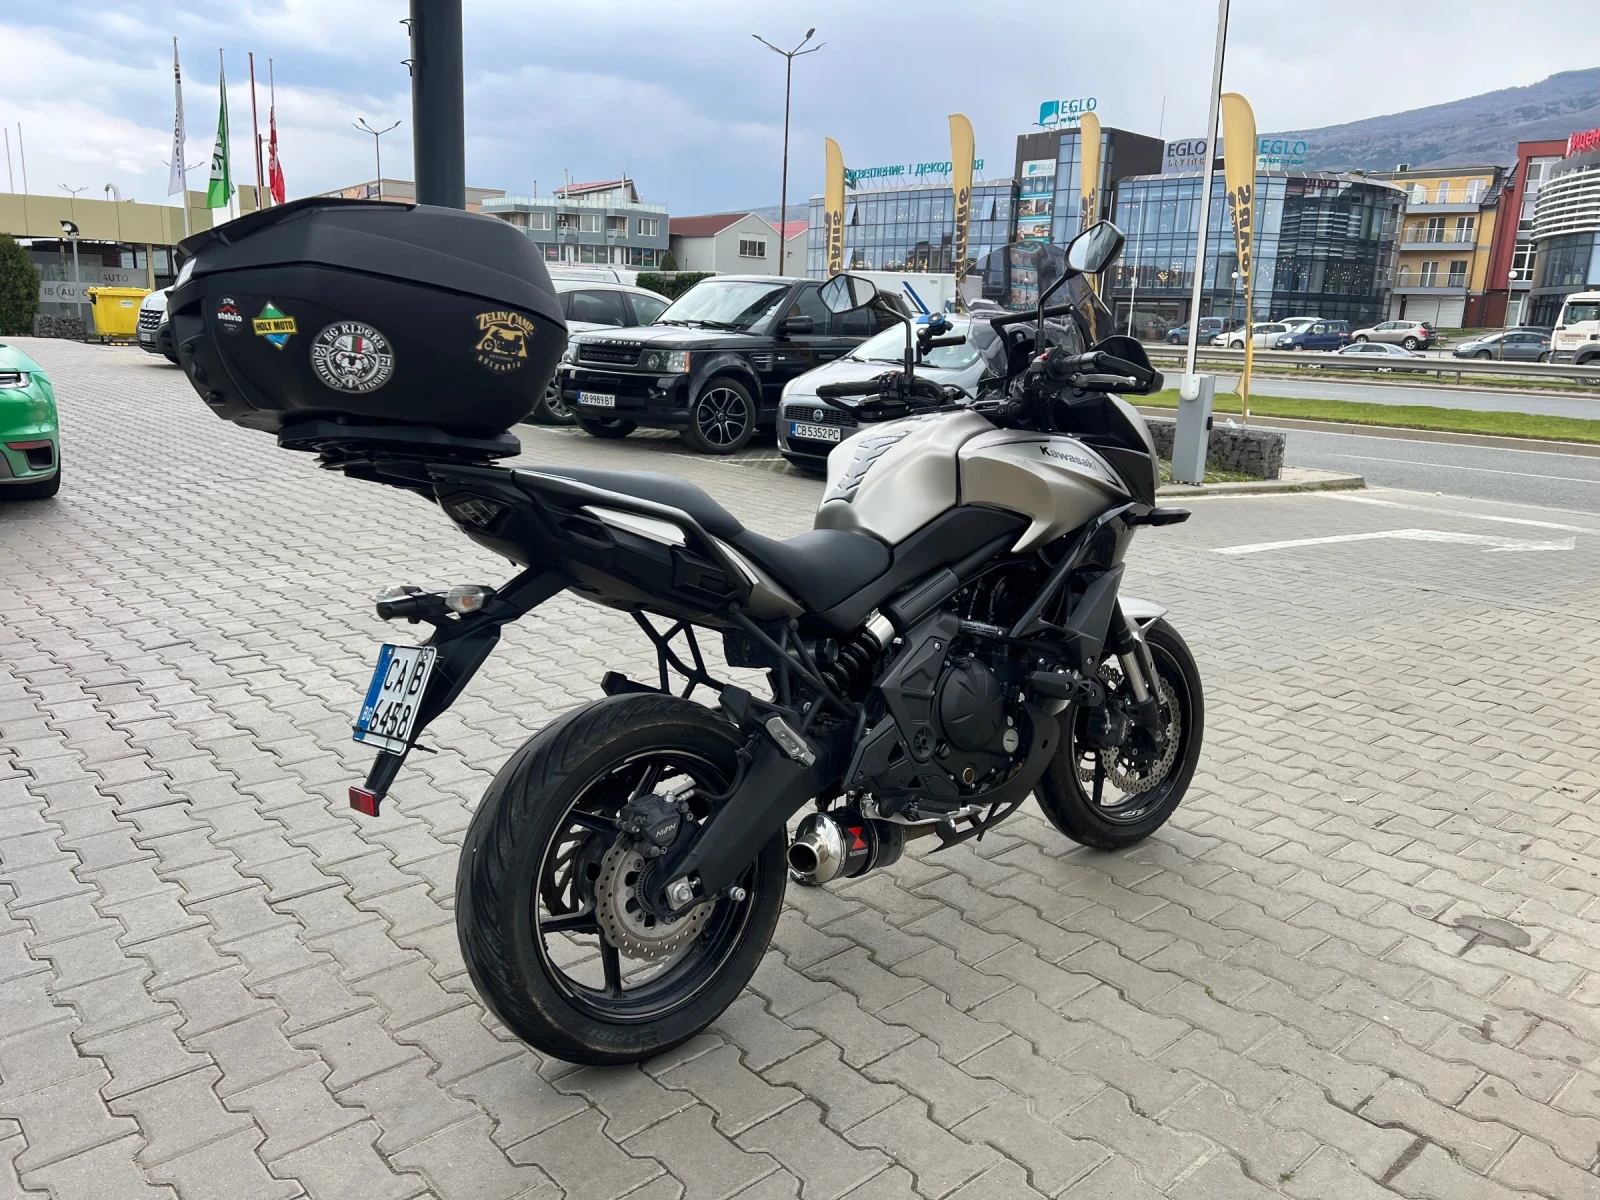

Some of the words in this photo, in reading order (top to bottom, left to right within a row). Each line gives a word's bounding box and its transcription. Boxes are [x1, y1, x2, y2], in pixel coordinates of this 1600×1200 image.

[1061, 97, 1097, 114] EGLO
[1167, 140, 1207, 157] EGLO
[1260, 139, 1307, 156] EGLO
[1037, 163, 1053, 171] EGLO
[102, 273, 128, 282] AUTO
[44, 287, 54, 296] IS
[217, 312, 243, 323] stelvio
[256, 321, 273, 332] HOLY
[273, 320, 295, 331] MOTO
[475, 311, 508, 330] ZELIN
[507, 312, 535, 334] CAMP
[323, 327, 339, 342] BG
[341, 324, 385, 349] RIDERS
[313, 346, 327, 357] 20
[380, 356, 391, 367] 21
[477, 354, 521, 371] BULGARIA
[315, 359, 343, 388] UNITED
[358, 367, 389, 391] BIKERS
[807, 426, 827, 439] 5352
[1039, 445, 1098, 472] Kawasaki
[361, 705, 373, 722] BG
[369, 698, 412, 738] 6458
